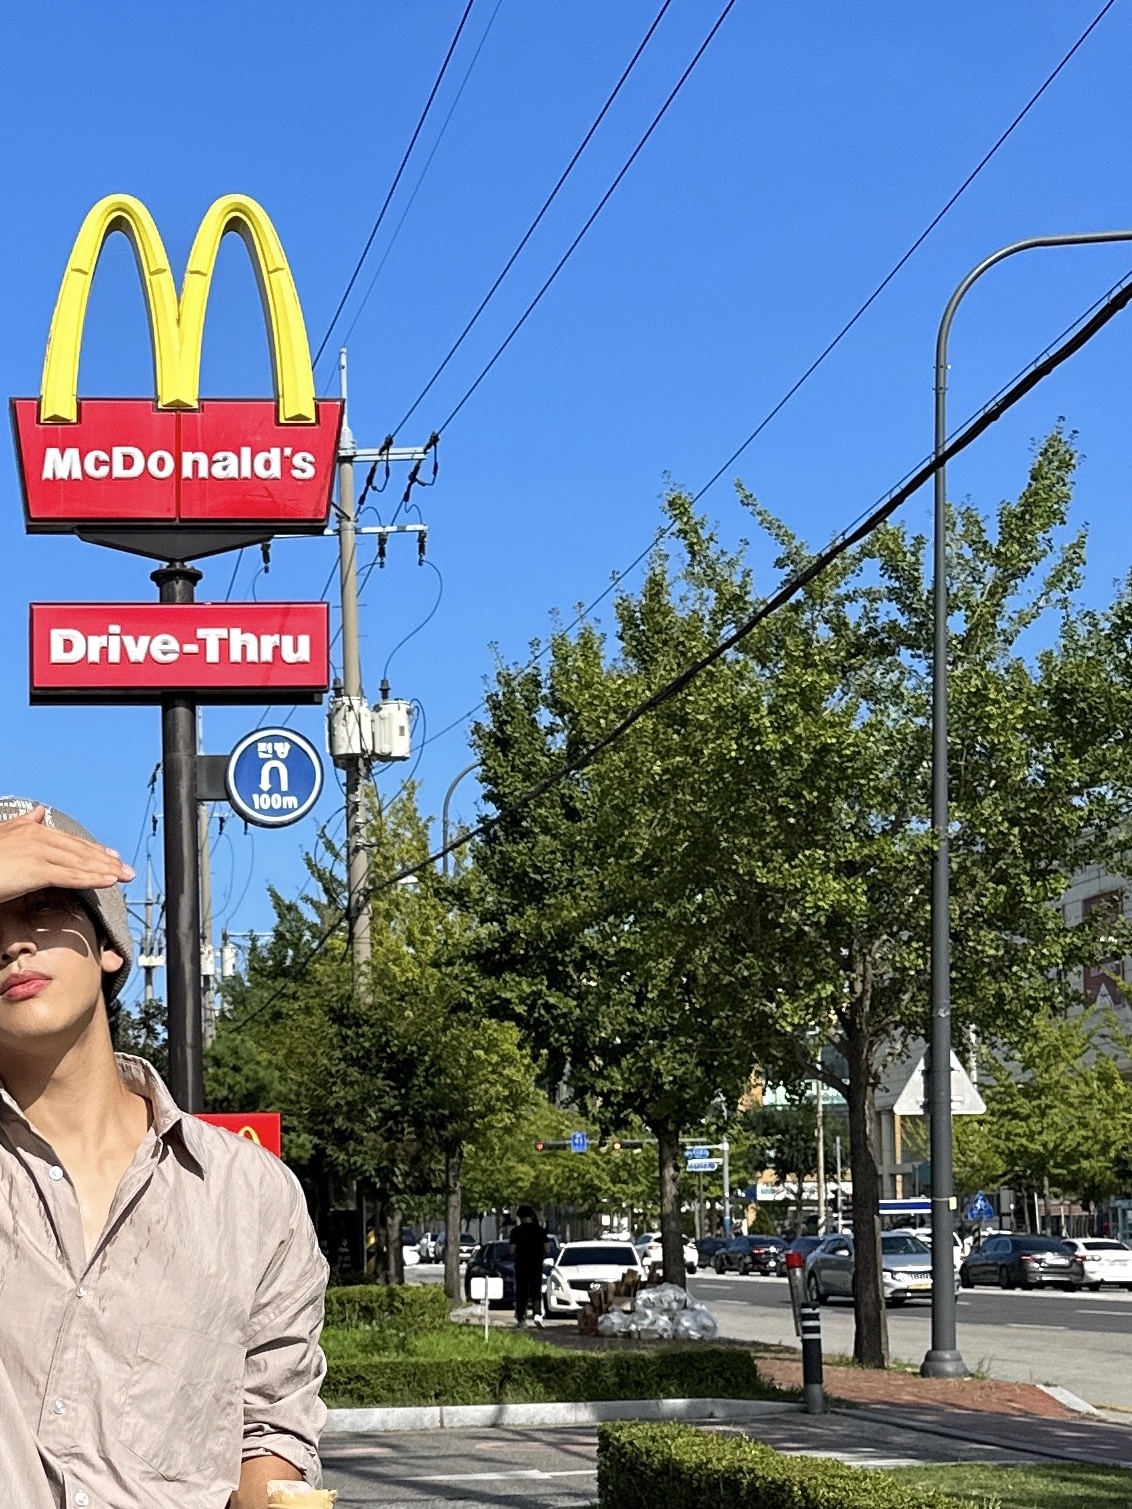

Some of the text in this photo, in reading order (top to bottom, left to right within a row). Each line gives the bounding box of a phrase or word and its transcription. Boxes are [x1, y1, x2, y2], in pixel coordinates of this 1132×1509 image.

[41, 446, 316, 481] McDonald's
[49, 624, 311, 665] Drive-Thru
[257, 742, 291, 759] 전방
[252, 793, 298, 810] 100m
